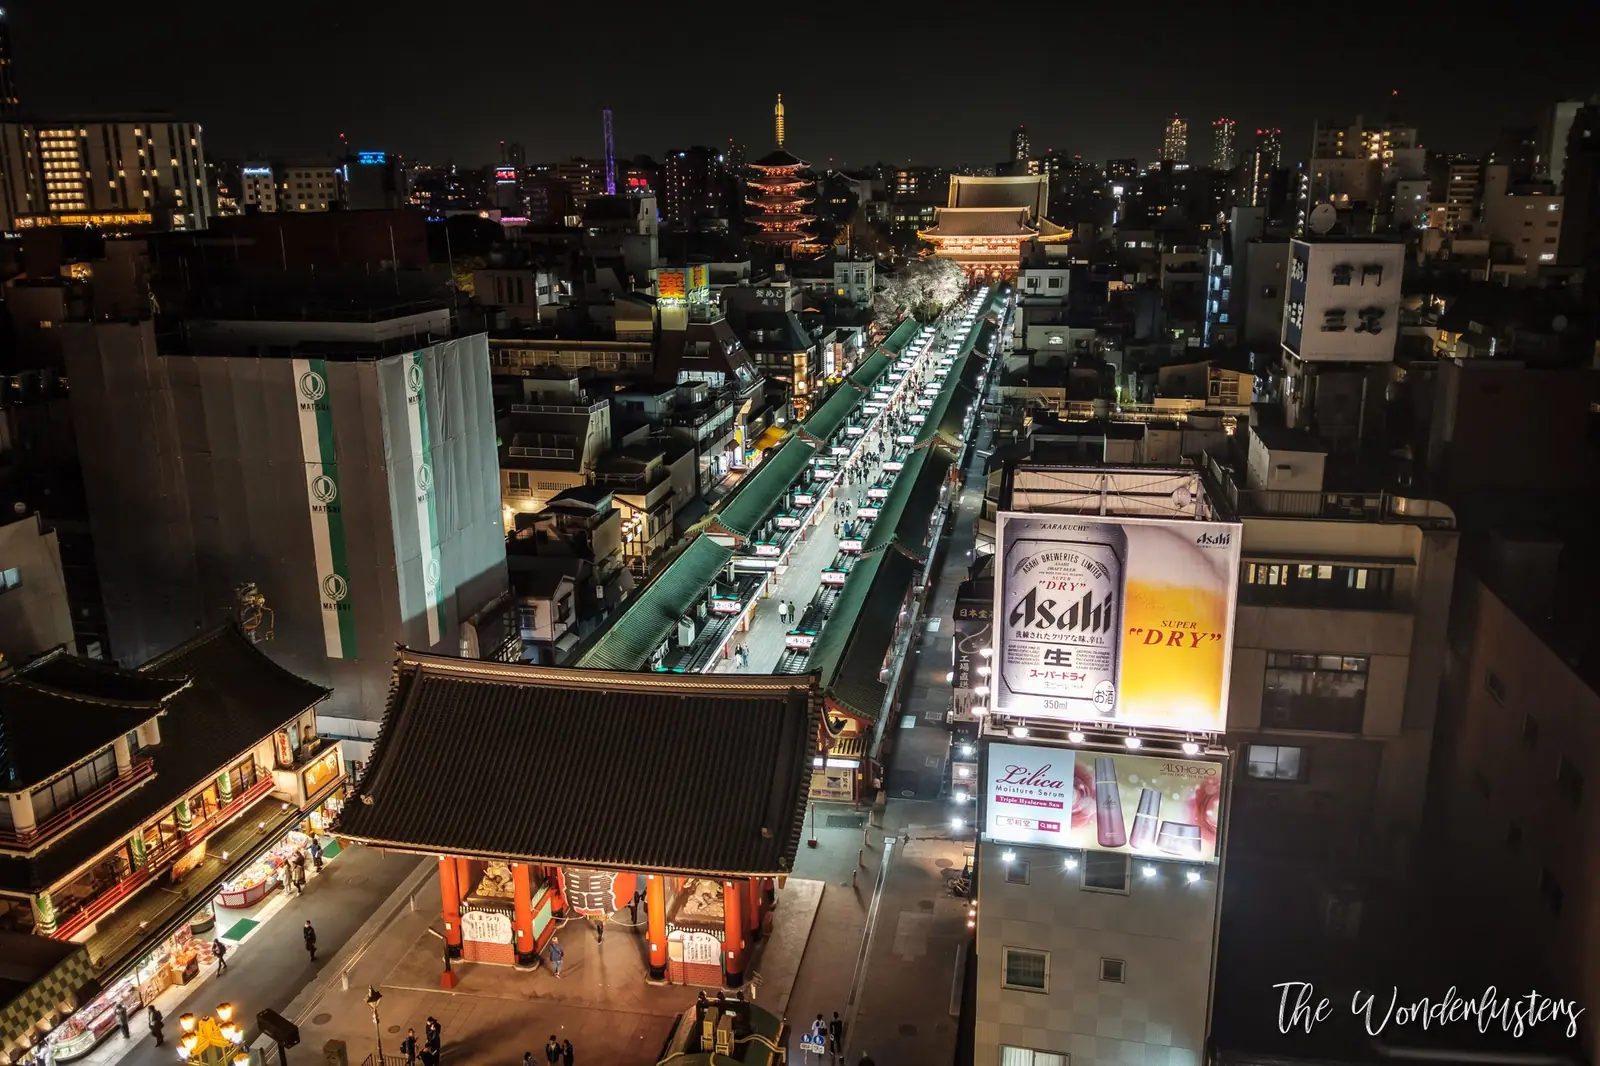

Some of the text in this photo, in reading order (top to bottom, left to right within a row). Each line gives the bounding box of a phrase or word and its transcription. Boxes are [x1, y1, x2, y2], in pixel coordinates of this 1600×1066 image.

[1332, 263, 1384, 287] 雷門
[1320, 305, 1386, 336] 三定
[1196, 532, 1230, 546] Asahi
[1022, 552, 1103, 580] ASAHI BREWERIES LIMITED
[1009, 586, 1113, 634] Asahi
[1160, 619, 1197, 630] SUPER
[1043, 648, 1072, 668] 生
[1029, 669, 1087, 681] スーパードライ
[1043, 699, 1068, 710] 350ml
[996, 763, 1065, 789] Lilica
[996, 785, 1065, 798] Moisture Serum
[1000, 796, 1018, 804] Triple
